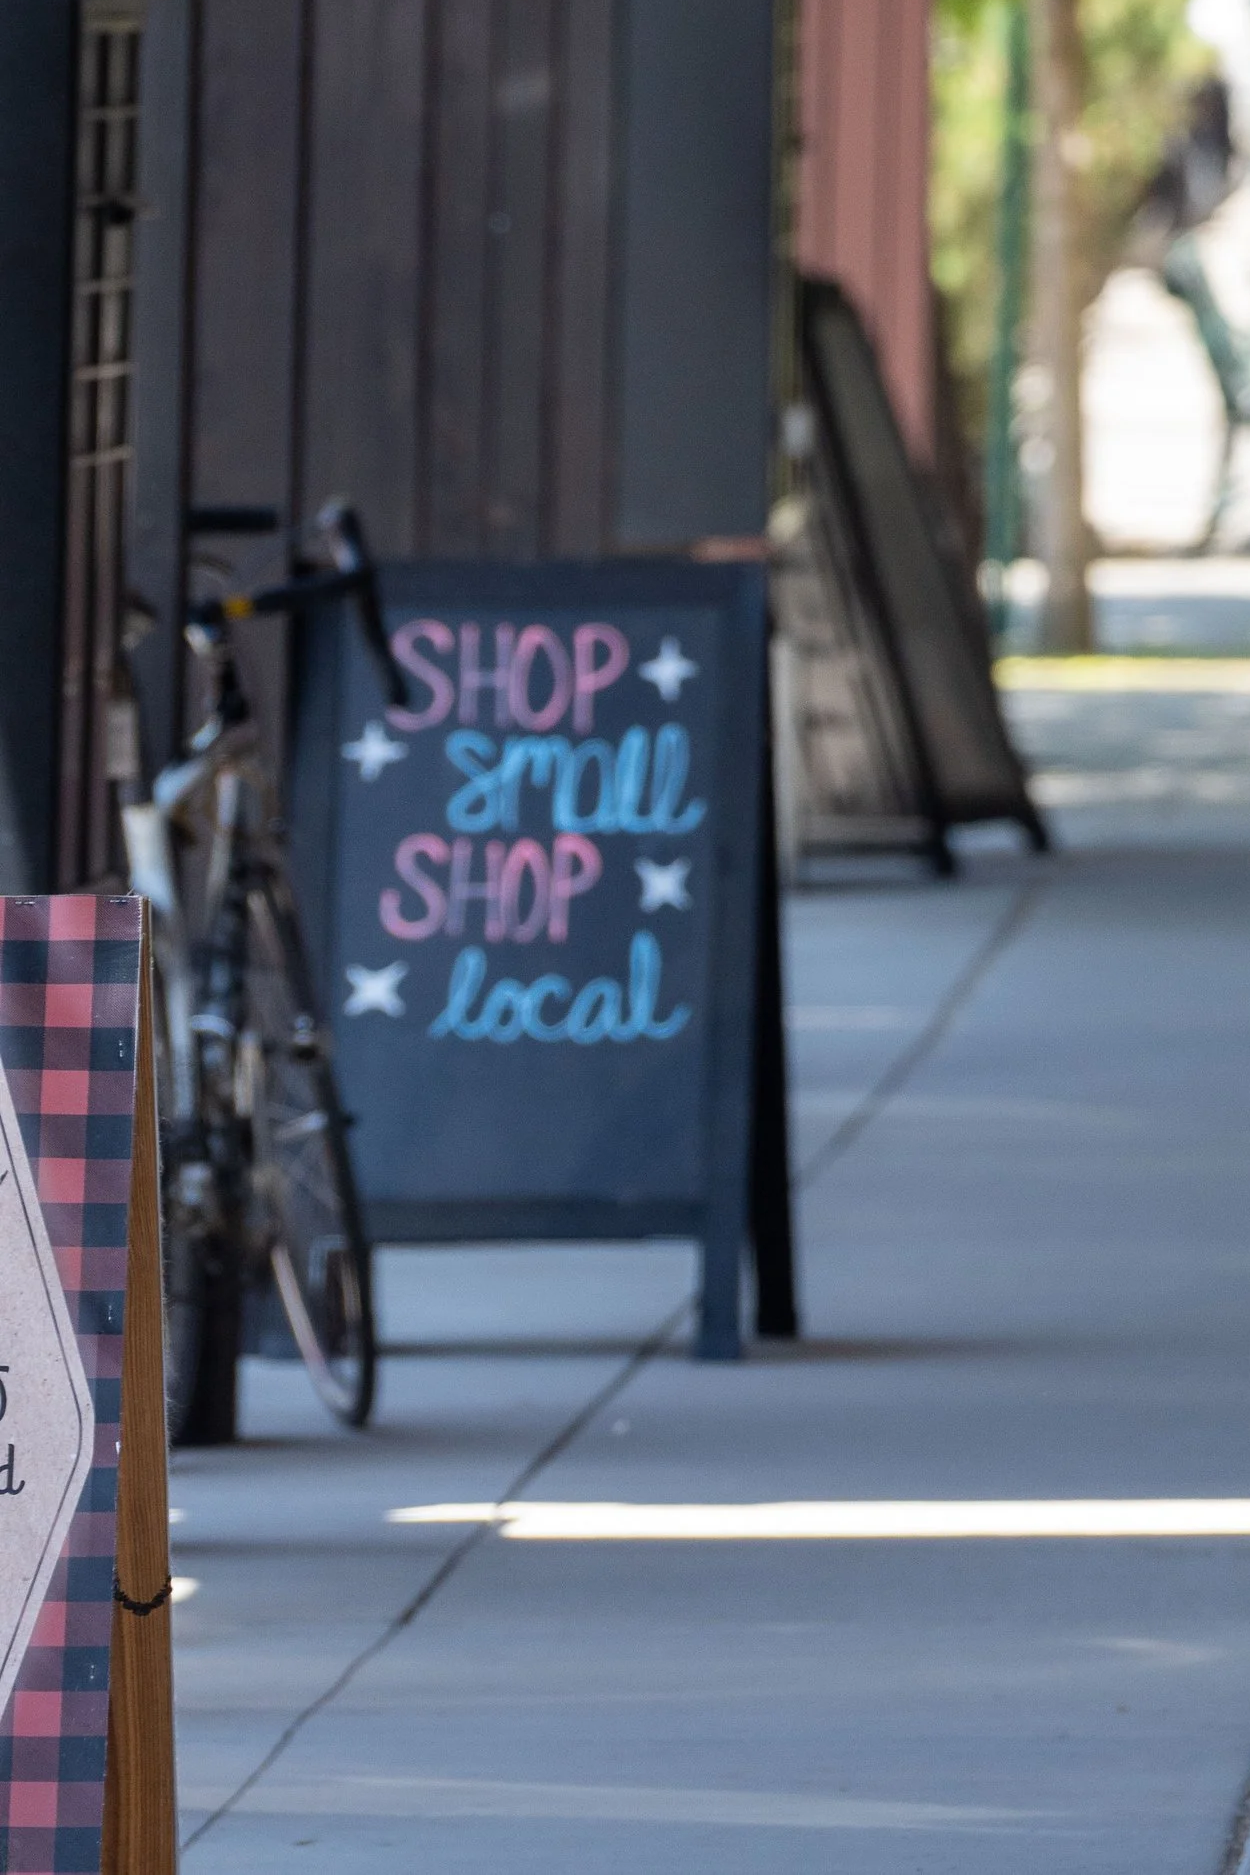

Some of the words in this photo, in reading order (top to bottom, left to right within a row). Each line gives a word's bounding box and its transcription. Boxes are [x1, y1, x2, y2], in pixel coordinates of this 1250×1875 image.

[384, 618, 631, 733] SHOP
[444, 722, 708, 835] small
[379, 832, 604, 944] SHOP
[427, 929, 693, 1045] local
